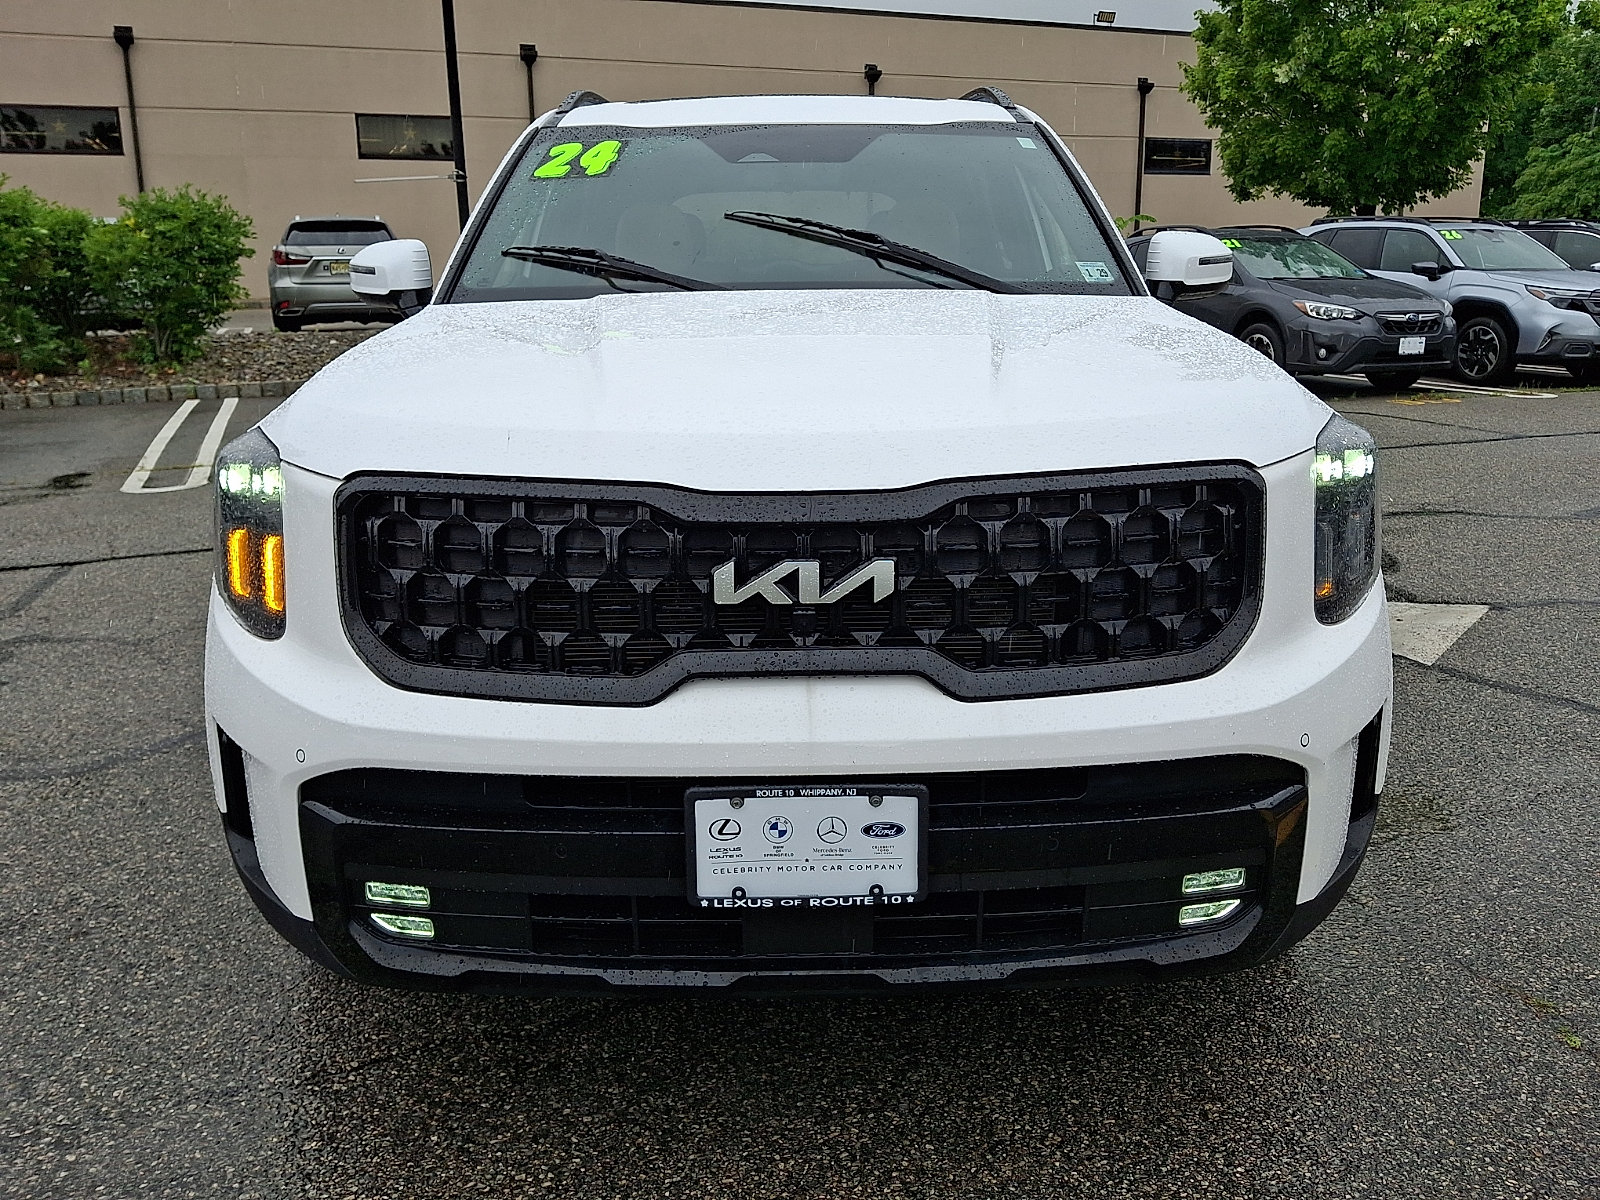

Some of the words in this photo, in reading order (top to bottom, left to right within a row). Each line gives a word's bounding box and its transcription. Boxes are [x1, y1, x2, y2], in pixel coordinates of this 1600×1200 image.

[534, 140, 622, 177] 24
[1221, 238, 1243, 248] 21
[713, 558, 895, 605] KIA
[756, 789, 783, 797] ROUTE
[785, 789, 795, 797] 10
[846, 788, 857, 796] NJ
[869, 824, 897, 836] Ford
[712, 866, 771, 875] CELEBRITY
[777, 865, 816, 873] MOTOR
[822, 864, 843, 872] CAR
[848, 863, 903, 871] COMPANY
[713, 899, 774, 908] LEXUS
[780, 899, 802, 907] OF
[809, 896, 874, 907] ROUTE
[881, 895, 902, 905] 10
